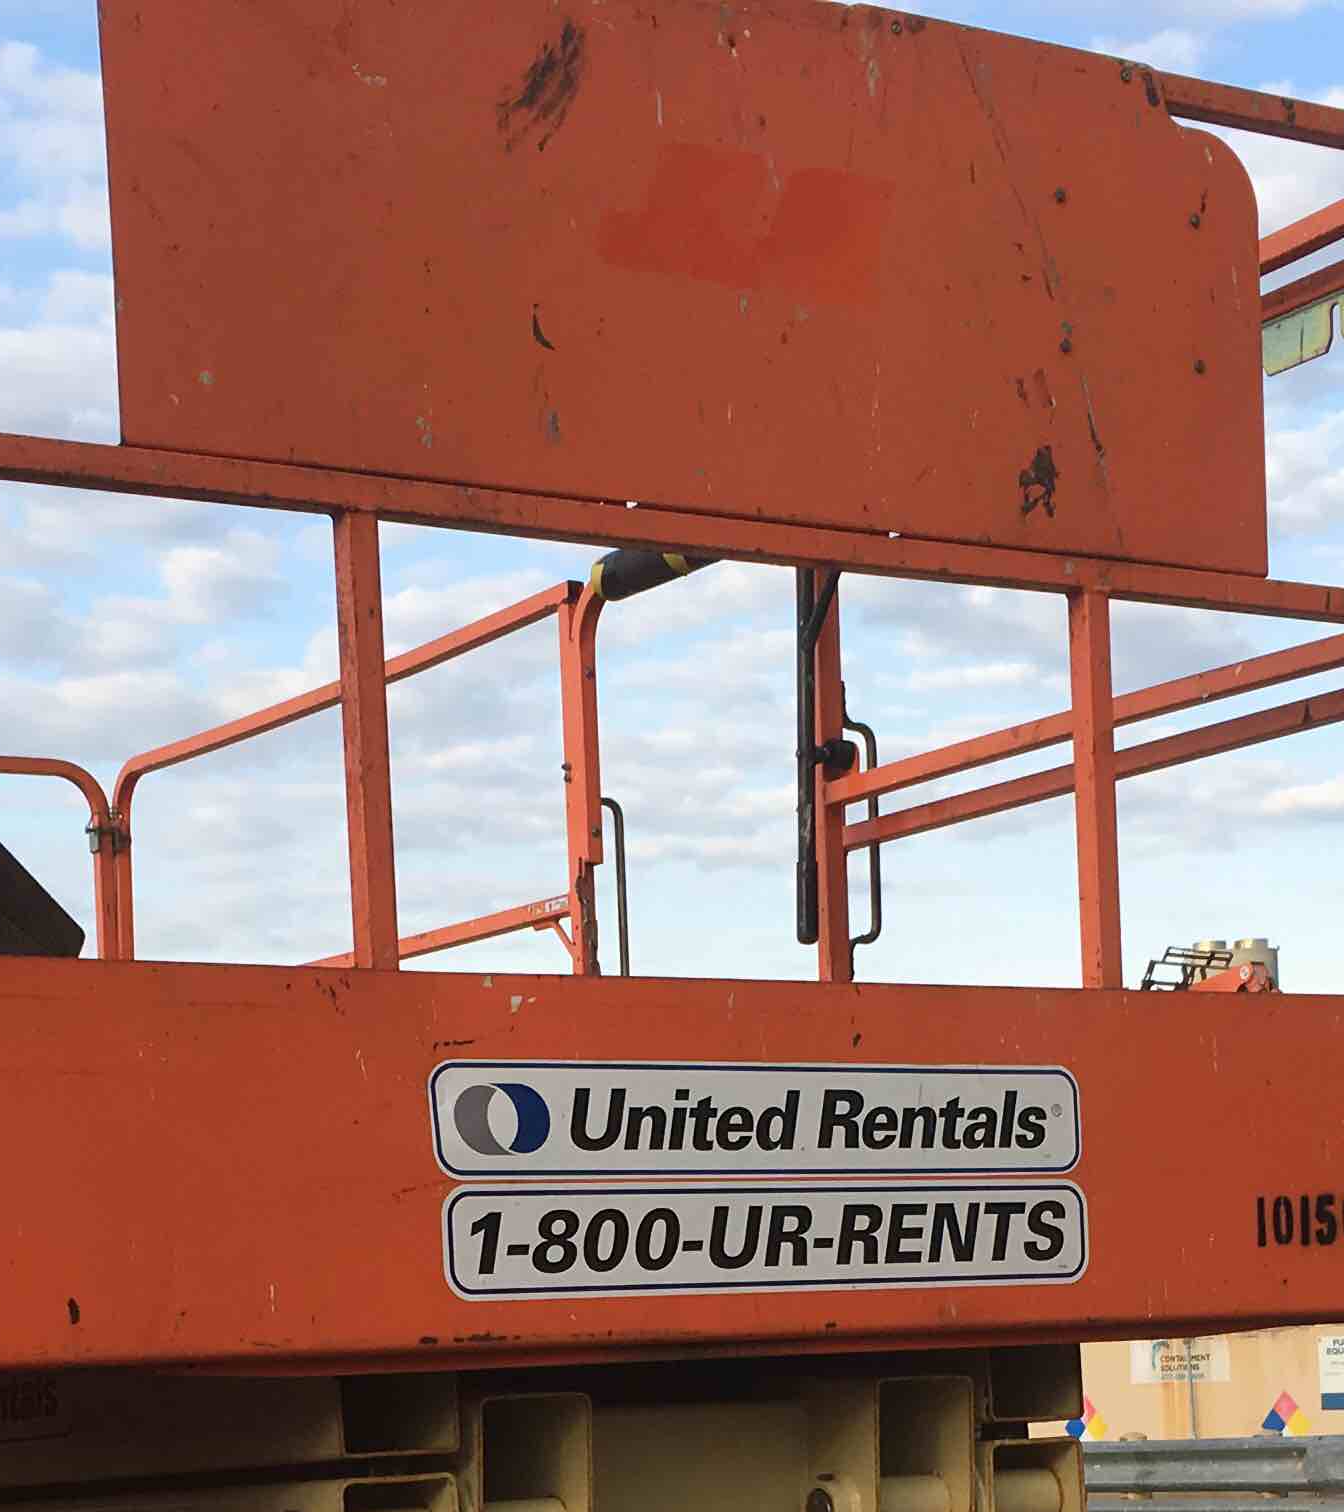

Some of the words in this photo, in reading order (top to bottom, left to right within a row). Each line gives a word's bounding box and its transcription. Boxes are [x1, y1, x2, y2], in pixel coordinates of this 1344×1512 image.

[570, 1087, 801, 1151] United
[817, 1089, 1047, 1150] Rentals
[469, 1200, 1067, 1275] 1-800-UR-RENTS
